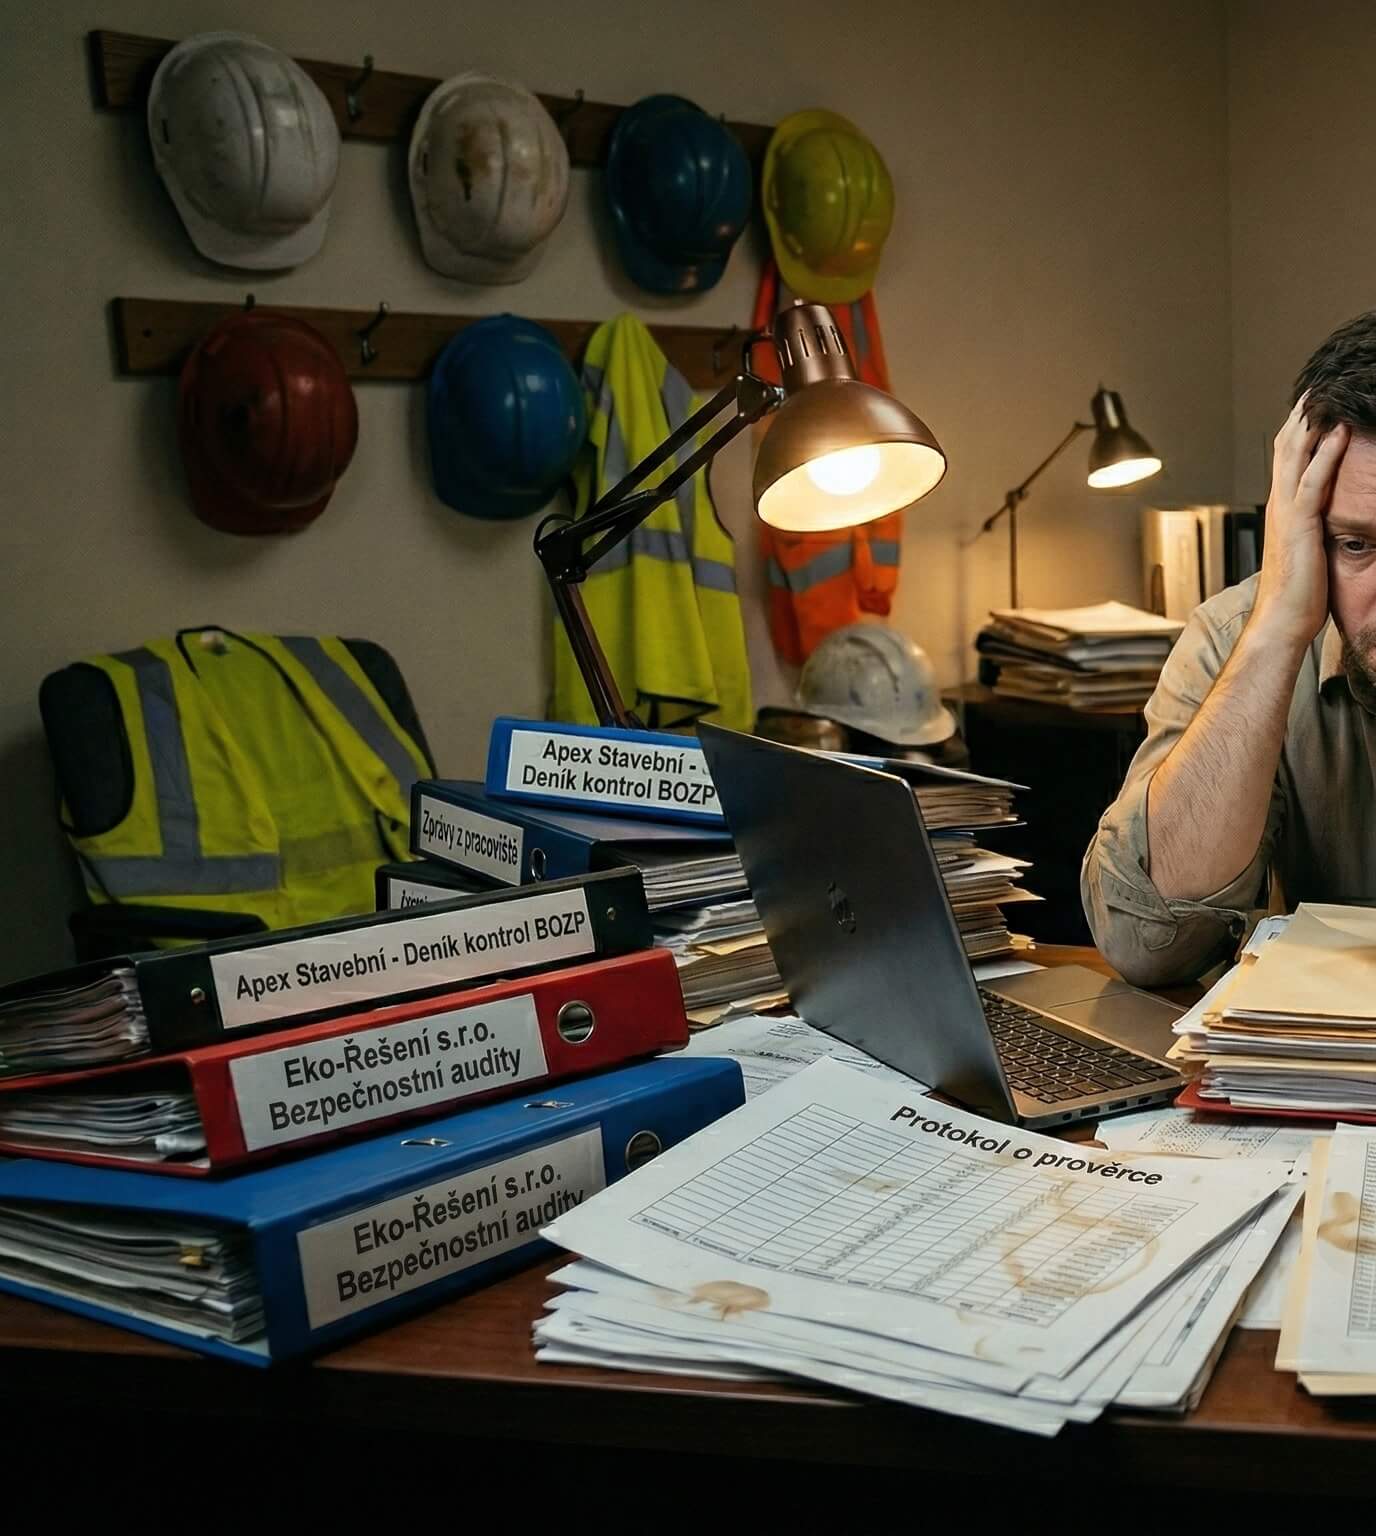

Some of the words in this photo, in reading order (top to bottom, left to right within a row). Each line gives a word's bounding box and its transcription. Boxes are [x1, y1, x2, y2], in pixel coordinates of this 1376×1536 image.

[522, 765, 576, 791] Deník
[582, 776, 652, 799] kontrol
[657, 780, 716, 806] BOZP
[542, 740, 593, 766] Apex
[598, 745, 685, 774] Stavební
[422, 809, 455, 847] Zprávy
[456, 827, 463, 847] z
[464, 828, 518, 866] pracoviště
[236, 973, 291, 1002] Apex
[297, 947, 386, 986] Stavební
[404, 934, 459, 966] Deník
[465, 920, 530, 953] kontrol
[535, 910, 586, 940] BOZP
[269, 1061, 444, 1130] Bezpečnostní
[451, 1045, 522, 1084] audity
[284, 1028, 431, 1088] Eko-Řešení
[437, 1020, 496, 1051] s.r.o.
[890, 1105, 1011, 1154] Protokol
[1013, 1148, 1033, 1160] o
[1033, 1151, 1163, 1186] prověrce
[353, 1176, 498, 1255] Eko-Řešení
[505, 1164, 561, 1199] s.r.o.
[336, 1211, 509, 1301] Bezpečnostní
